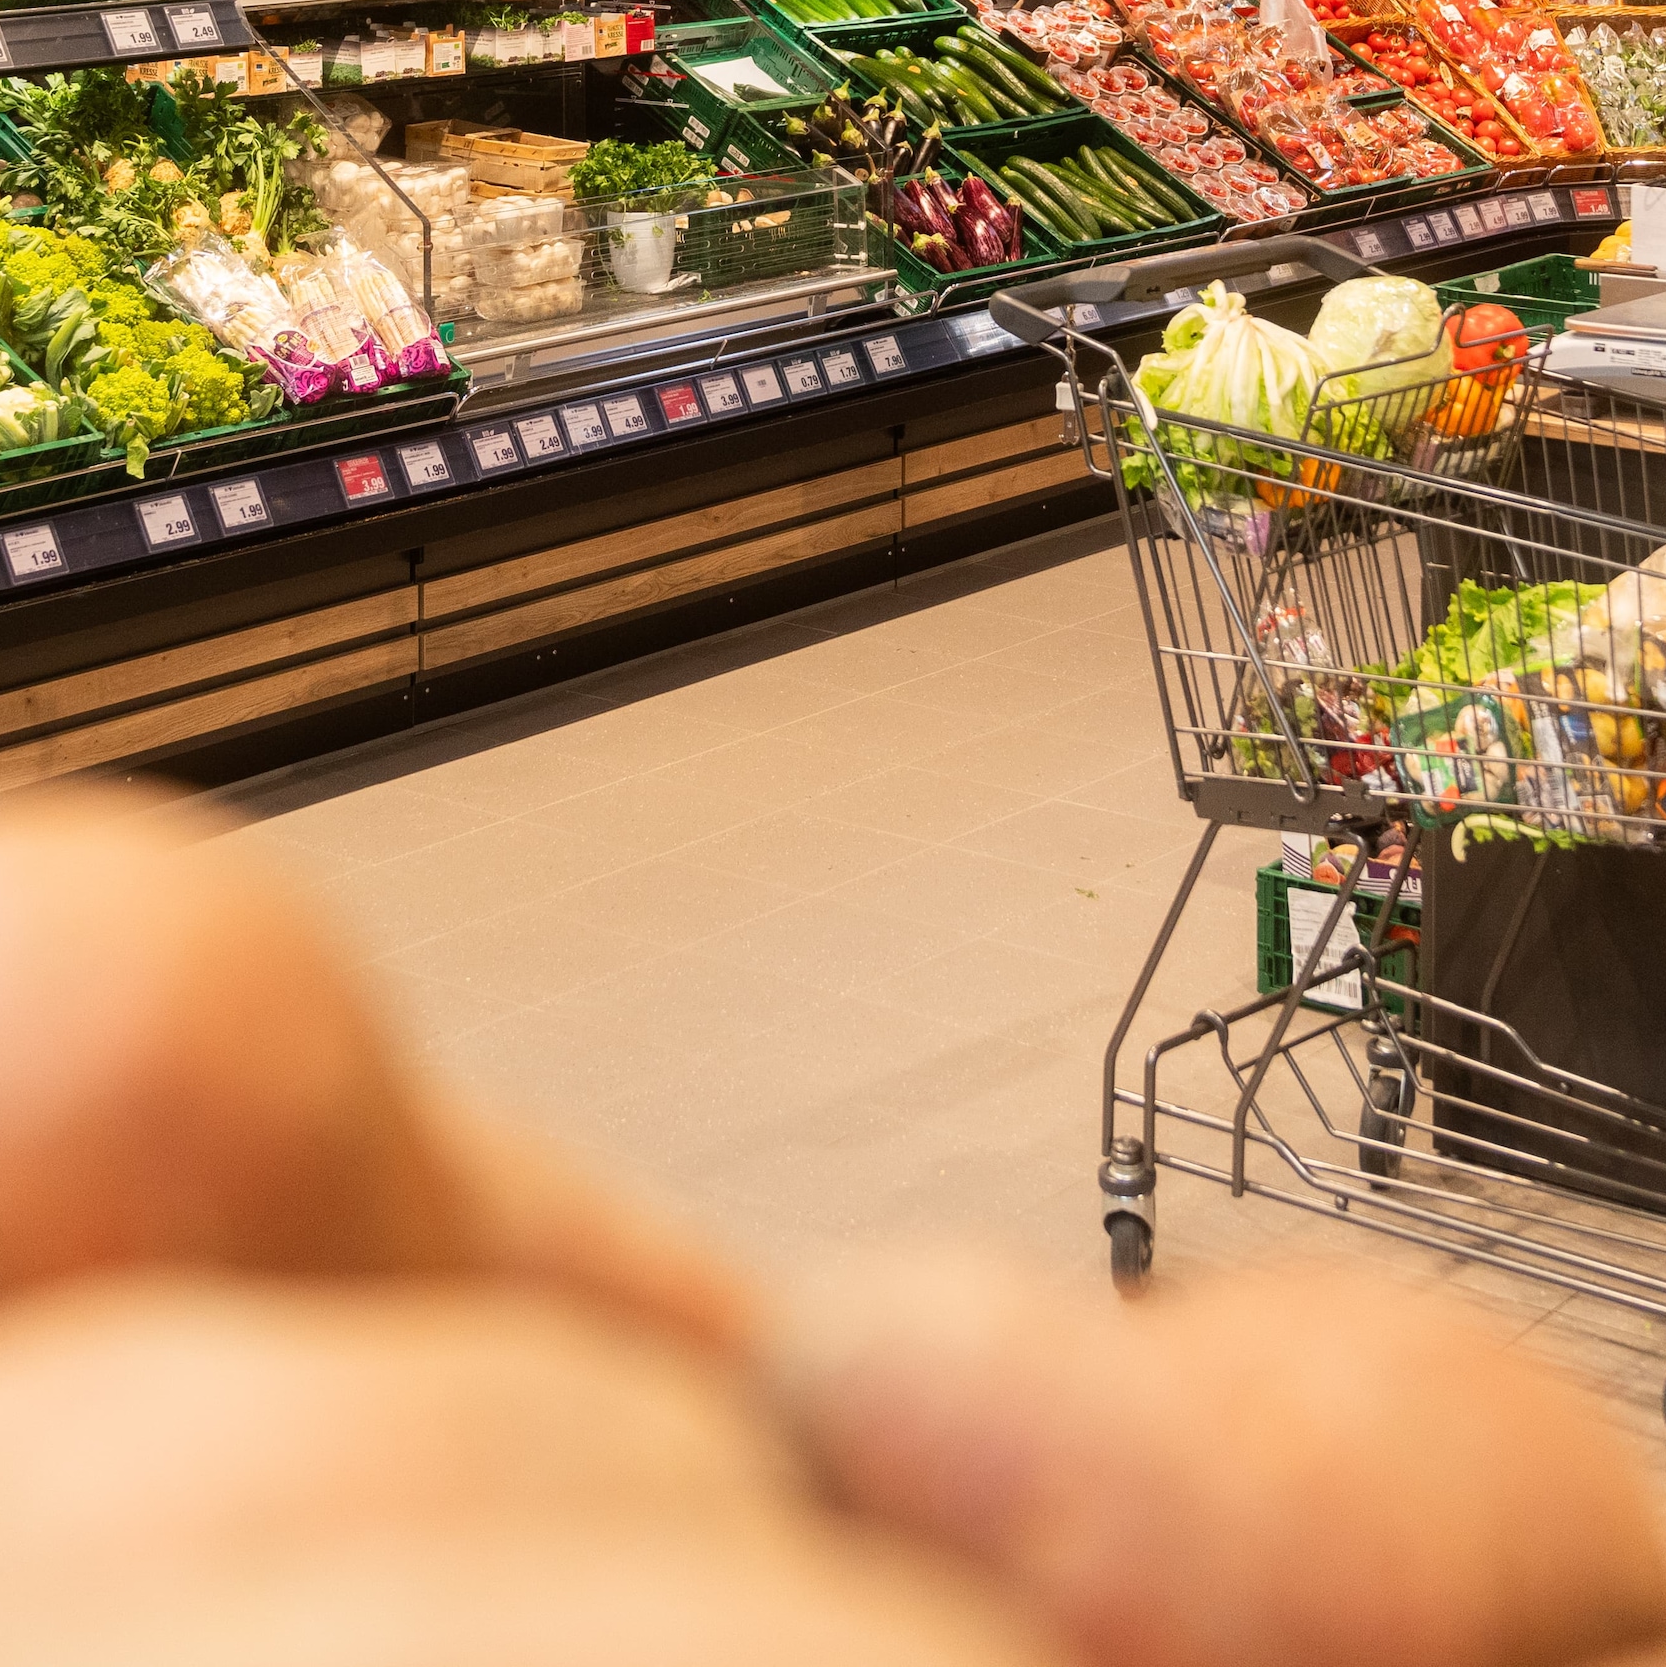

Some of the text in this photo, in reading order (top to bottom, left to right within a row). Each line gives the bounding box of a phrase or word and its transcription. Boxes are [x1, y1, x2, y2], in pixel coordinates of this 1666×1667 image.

[130, 32, 153, 44] 1.99
[192, 26, 215, 38] 2.49
[139, 67, 158, 77] KRESSE
[1589, 203, 1609, 214] 1.49
[885, 354, 904, 368] 7.90
[840, 365, 858, 379] 1.79
[801, 376, 819, 389] 0.79
[720, 393, 740, 408] 3.99
[679, 402, 699, 417] 1.99
[625, 415, 645, 430] 4.99
[584, 424, 604, 439] 3.99
[539, 436, 561, 451] 2.49
[493, 447, 515, 462] 1.99
[424, 462, 448, 479] 1.99
[361, 476, 386, 493] 3.99
[239, 503, 264, 519] 1.99
[165, 519, 191, 536] 2.99
[31, 549, 59, 567] 1.99
